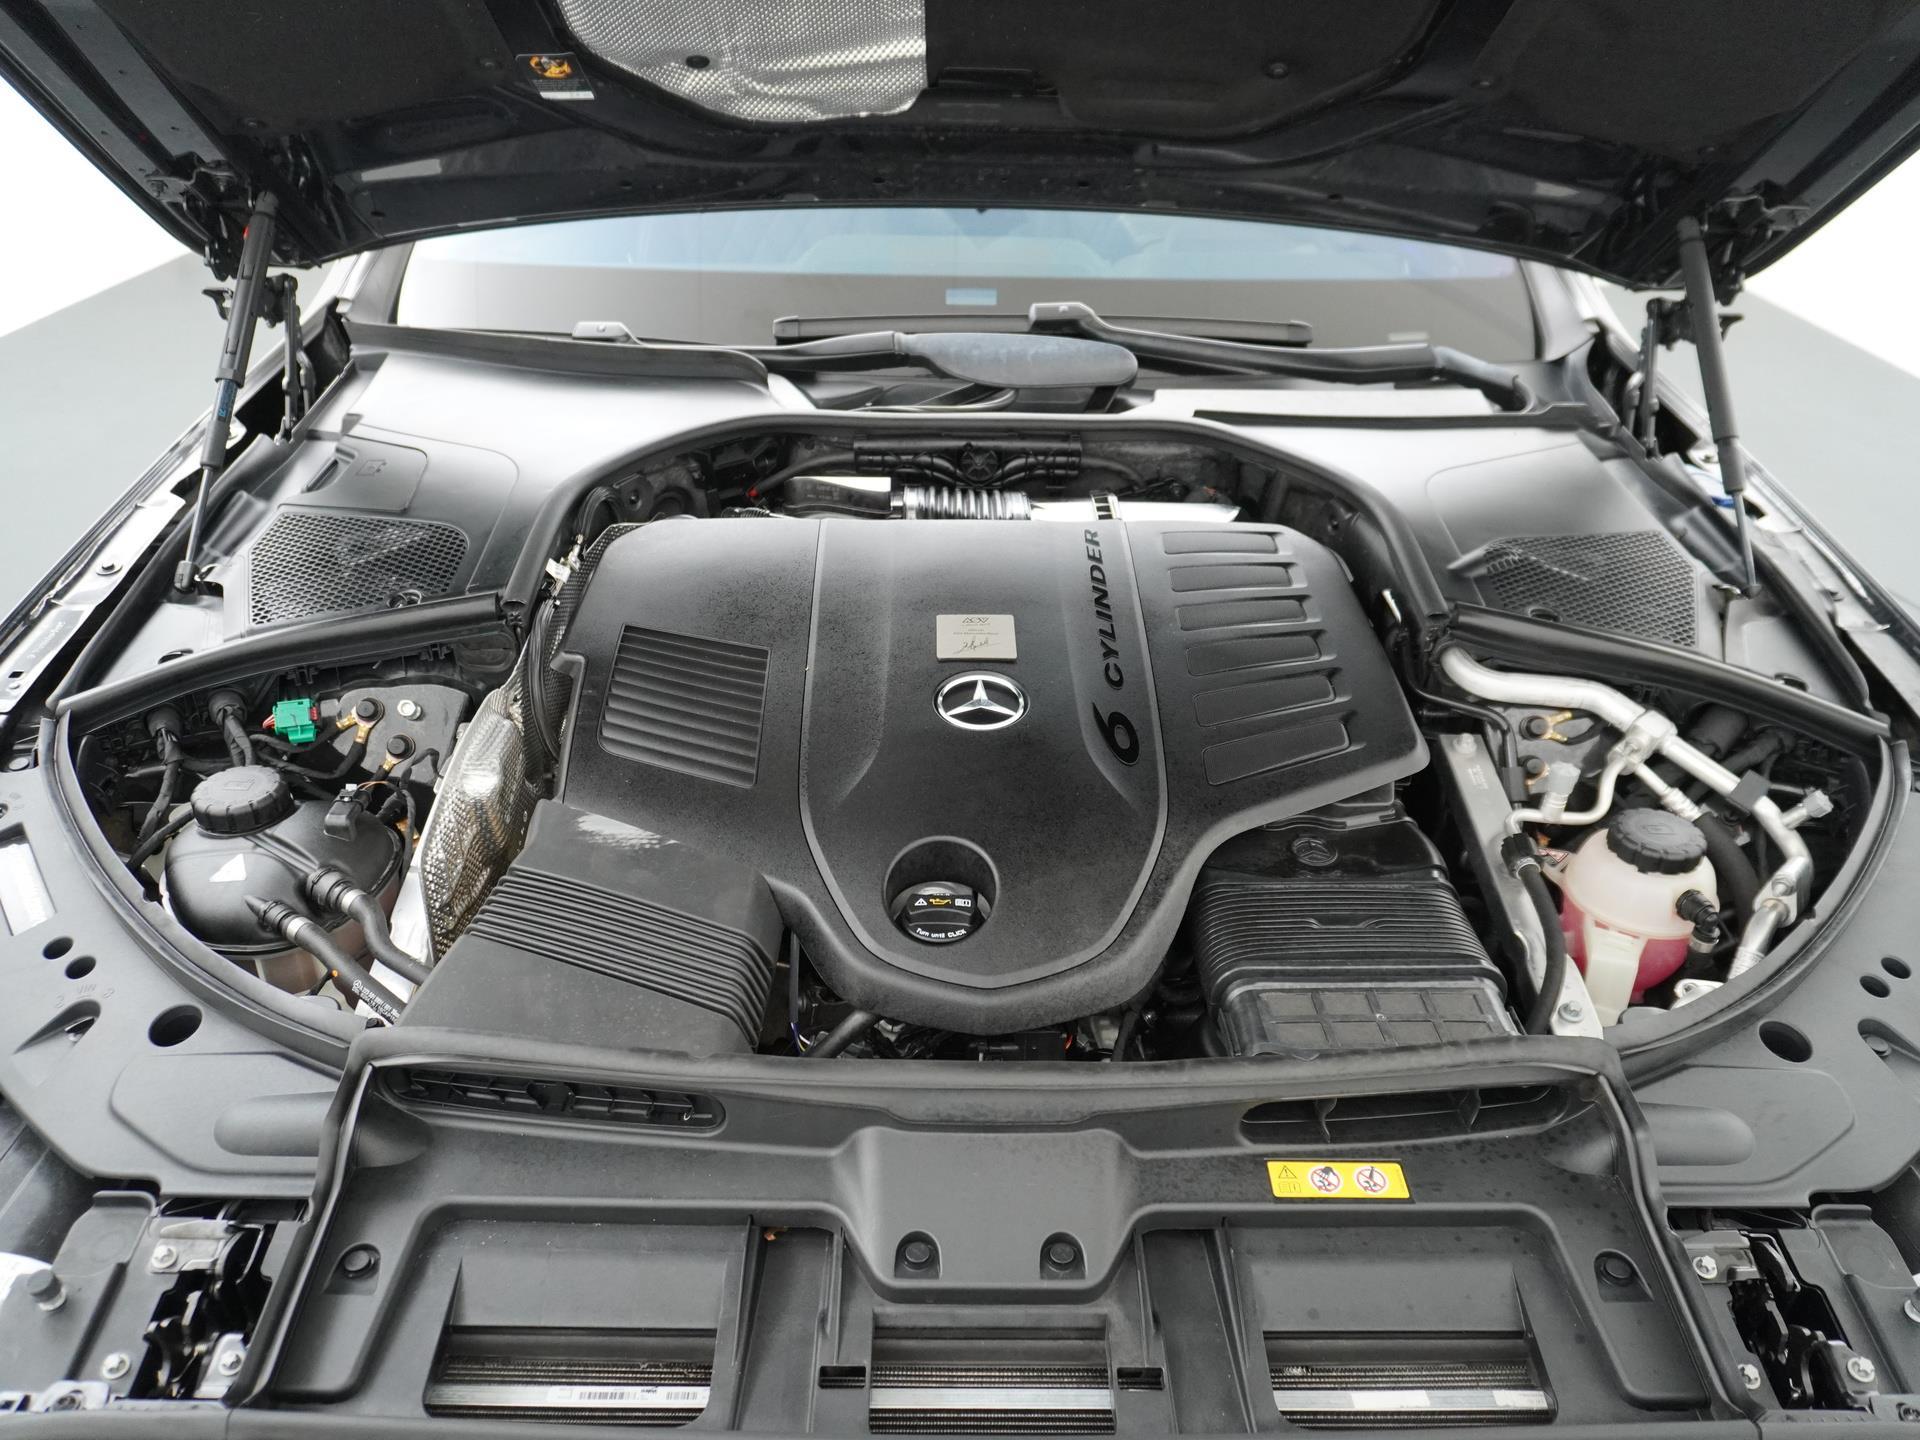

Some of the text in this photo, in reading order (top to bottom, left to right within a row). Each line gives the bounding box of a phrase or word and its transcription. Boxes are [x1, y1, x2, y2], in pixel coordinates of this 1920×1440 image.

[1084, 528, 1140, 767] 6 CYLINDER
[916, 927, 930, 937] Turn
[947, 928, 967, 938] CLICK
